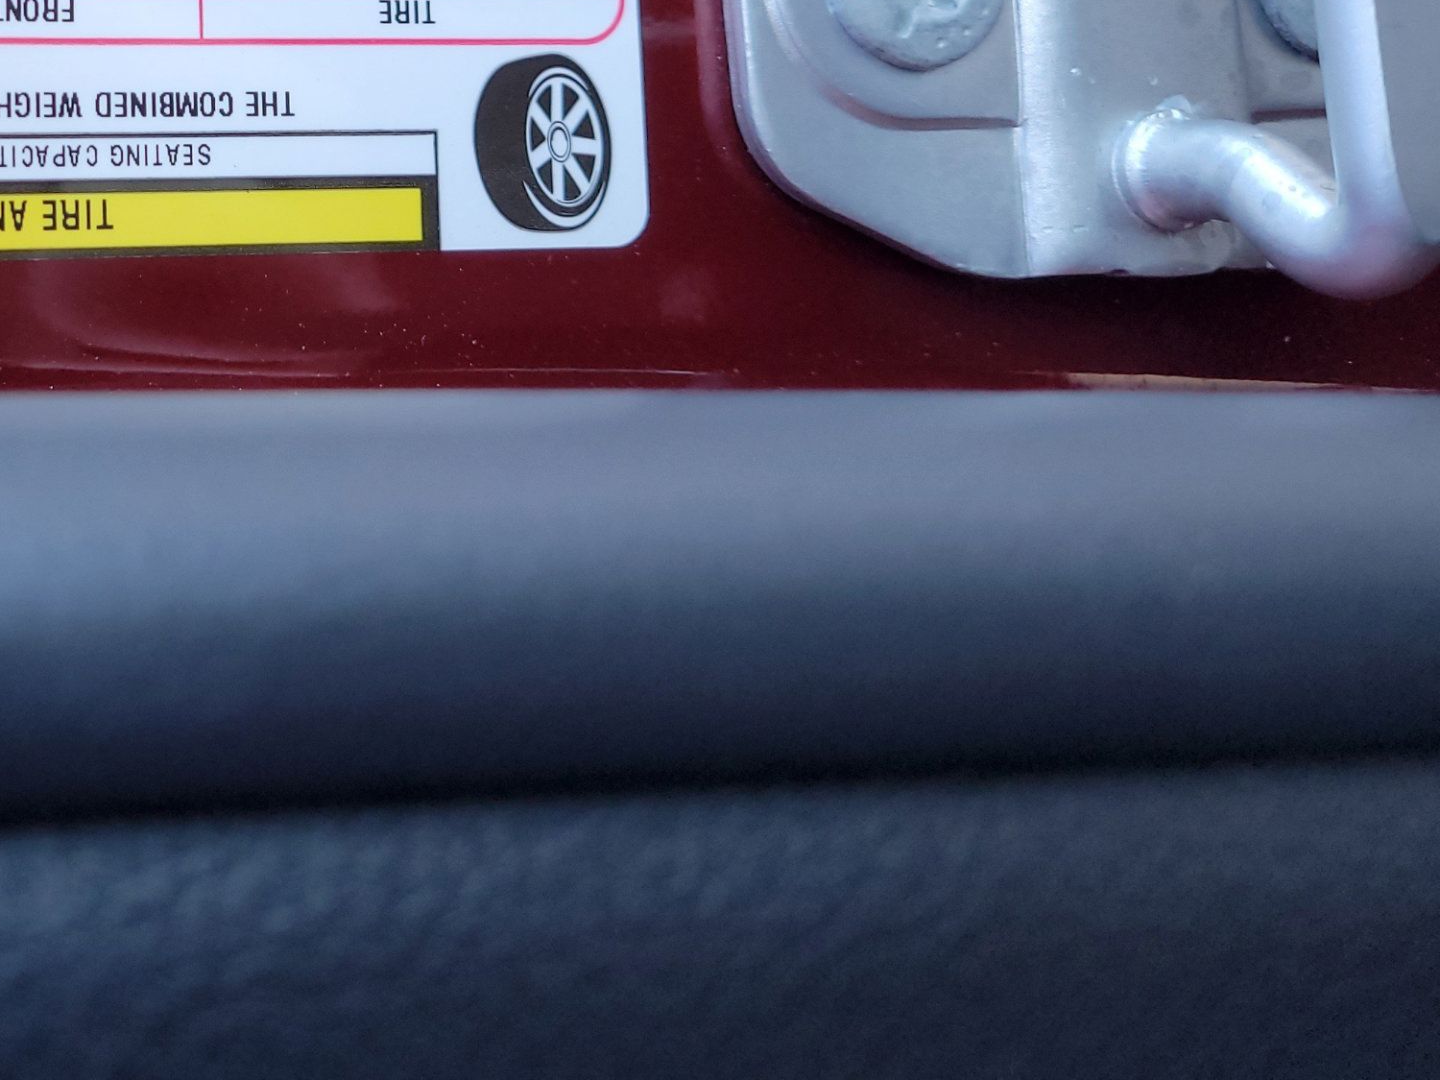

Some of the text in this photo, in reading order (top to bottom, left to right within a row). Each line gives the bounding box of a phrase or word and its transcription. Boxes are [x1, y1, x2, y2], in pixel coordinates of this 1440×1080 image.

[379, 0, 436, 25] TIRE
[95, 91, 234, 118] COMBINED
[245, 91, 296, 117] THE
[110, 143, 211, 167] SEATING
[42, 199, 114, 231] TIRE
